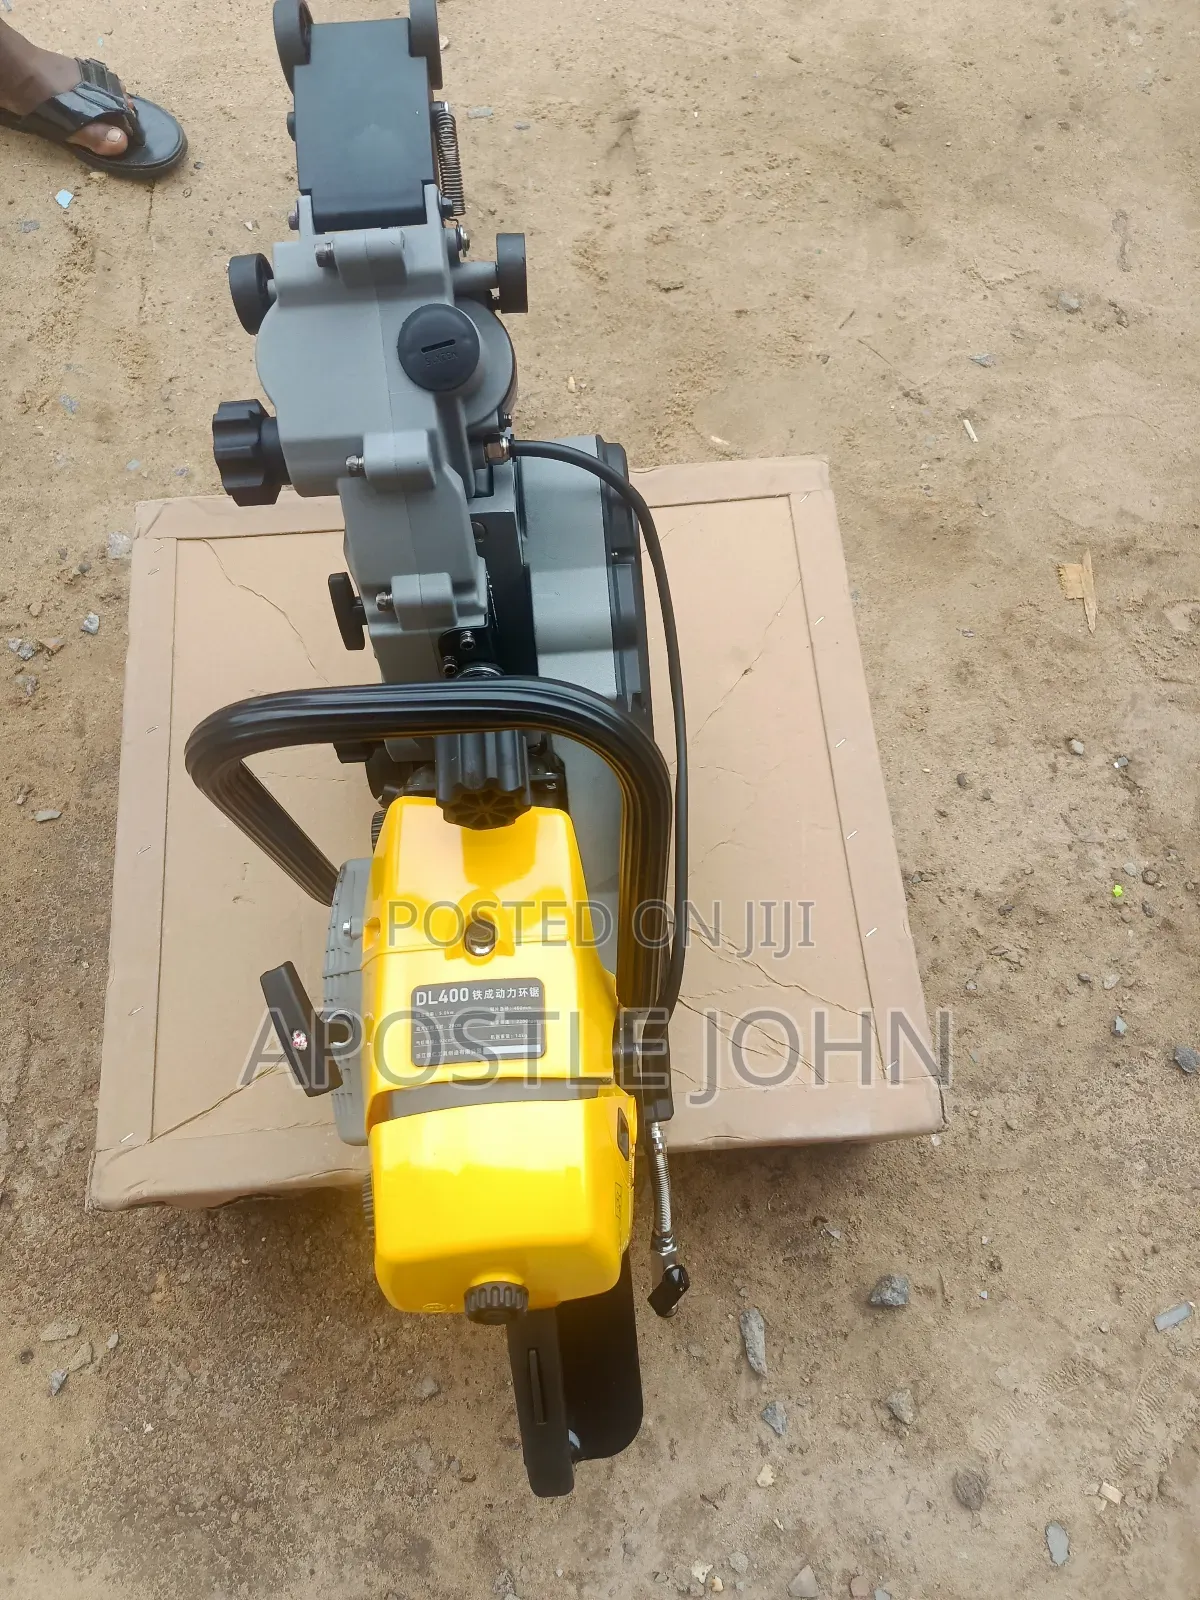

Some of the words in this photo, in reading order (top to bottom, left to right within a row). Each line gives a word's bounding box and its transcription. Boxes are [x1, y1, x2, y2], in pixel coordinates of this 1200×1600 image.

[416, 987, 469, 1006] DL400
[472, 986, 540, 1000] 铁成动力环锯
